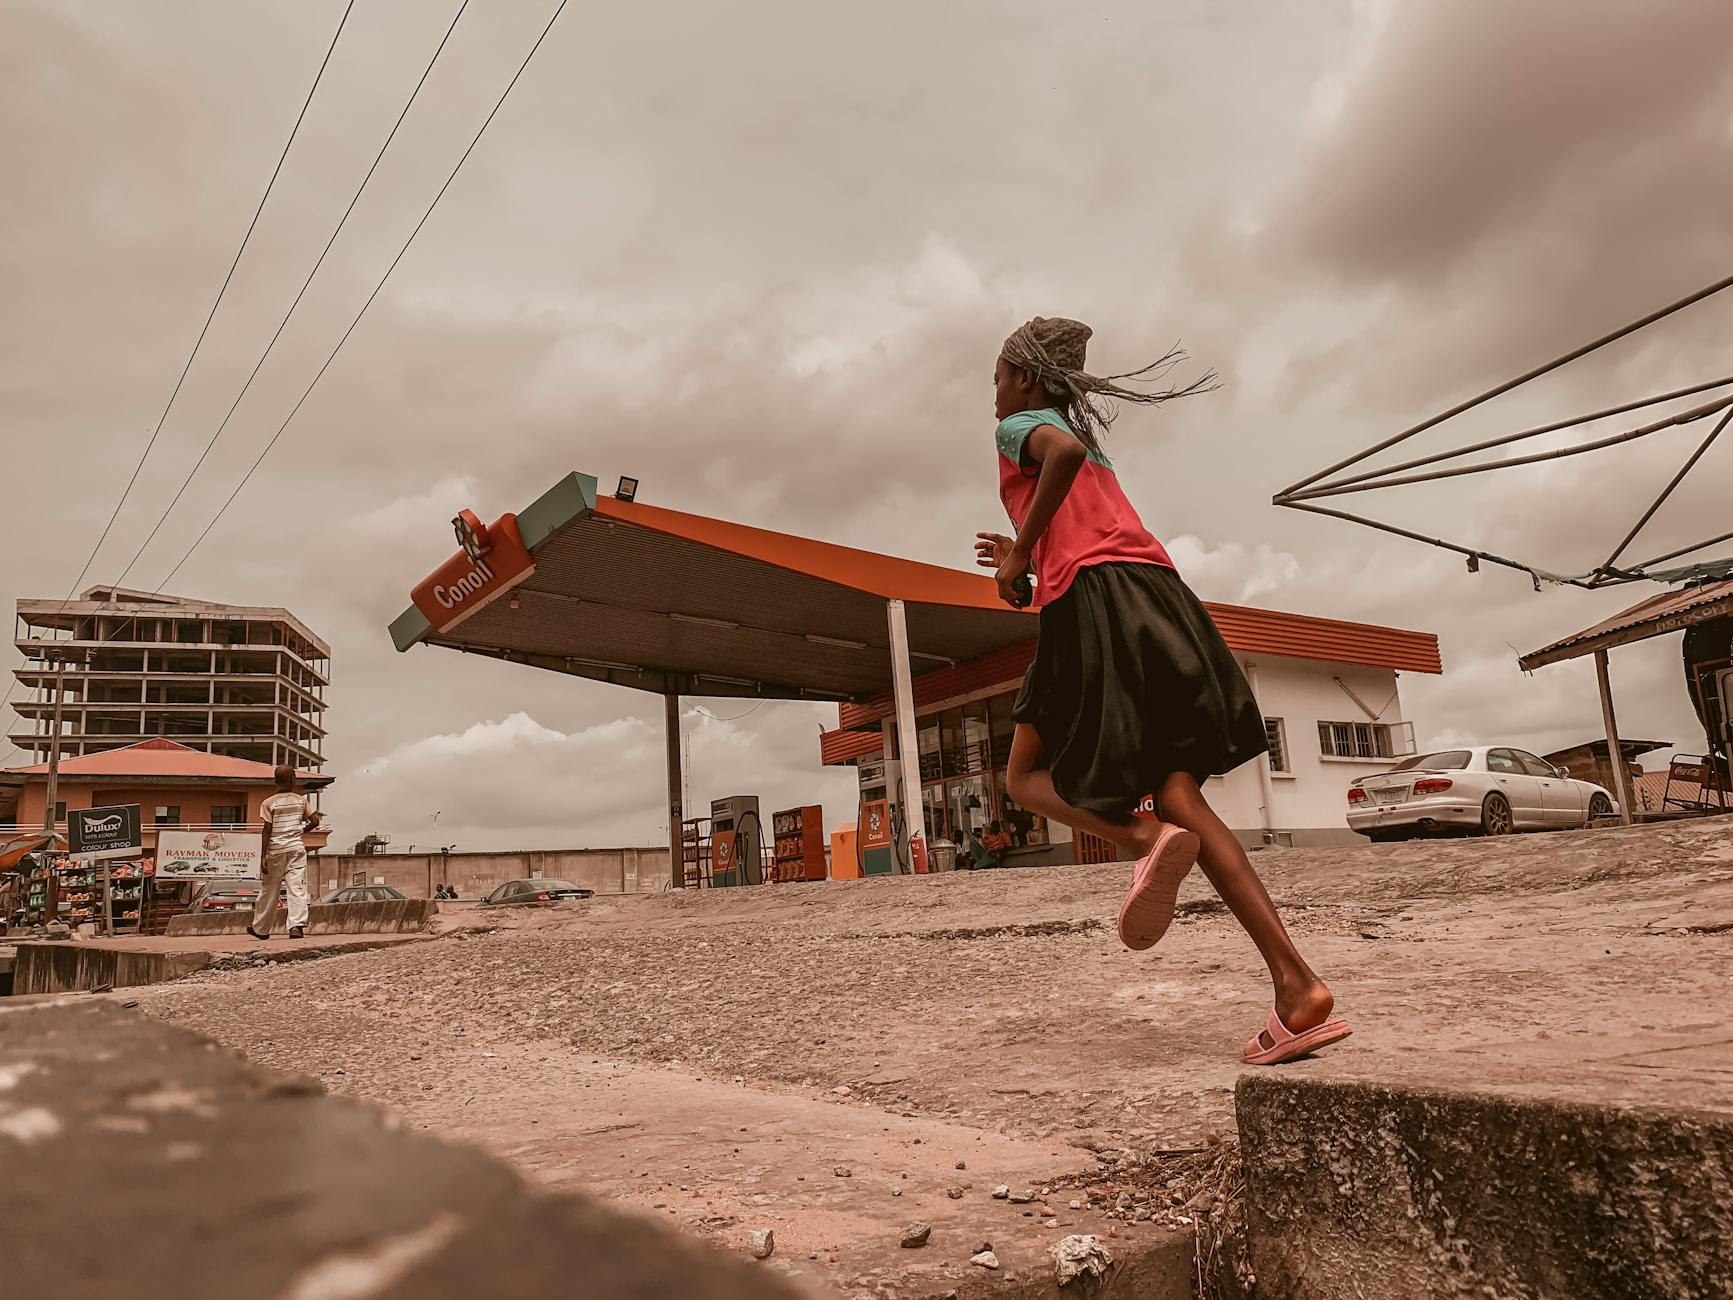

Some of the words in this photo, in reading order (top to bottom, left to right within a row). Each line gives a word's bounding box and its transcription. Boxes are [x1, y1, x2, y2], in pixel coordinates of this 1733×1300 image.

[433, 560, 493, 608] Conoil
[84, 823, 118, 833] Dulux
[81, 843, 107, 851] colour
[110, 841, 131, 849] shop
[166, 849, 209, 857] RAYMAK
